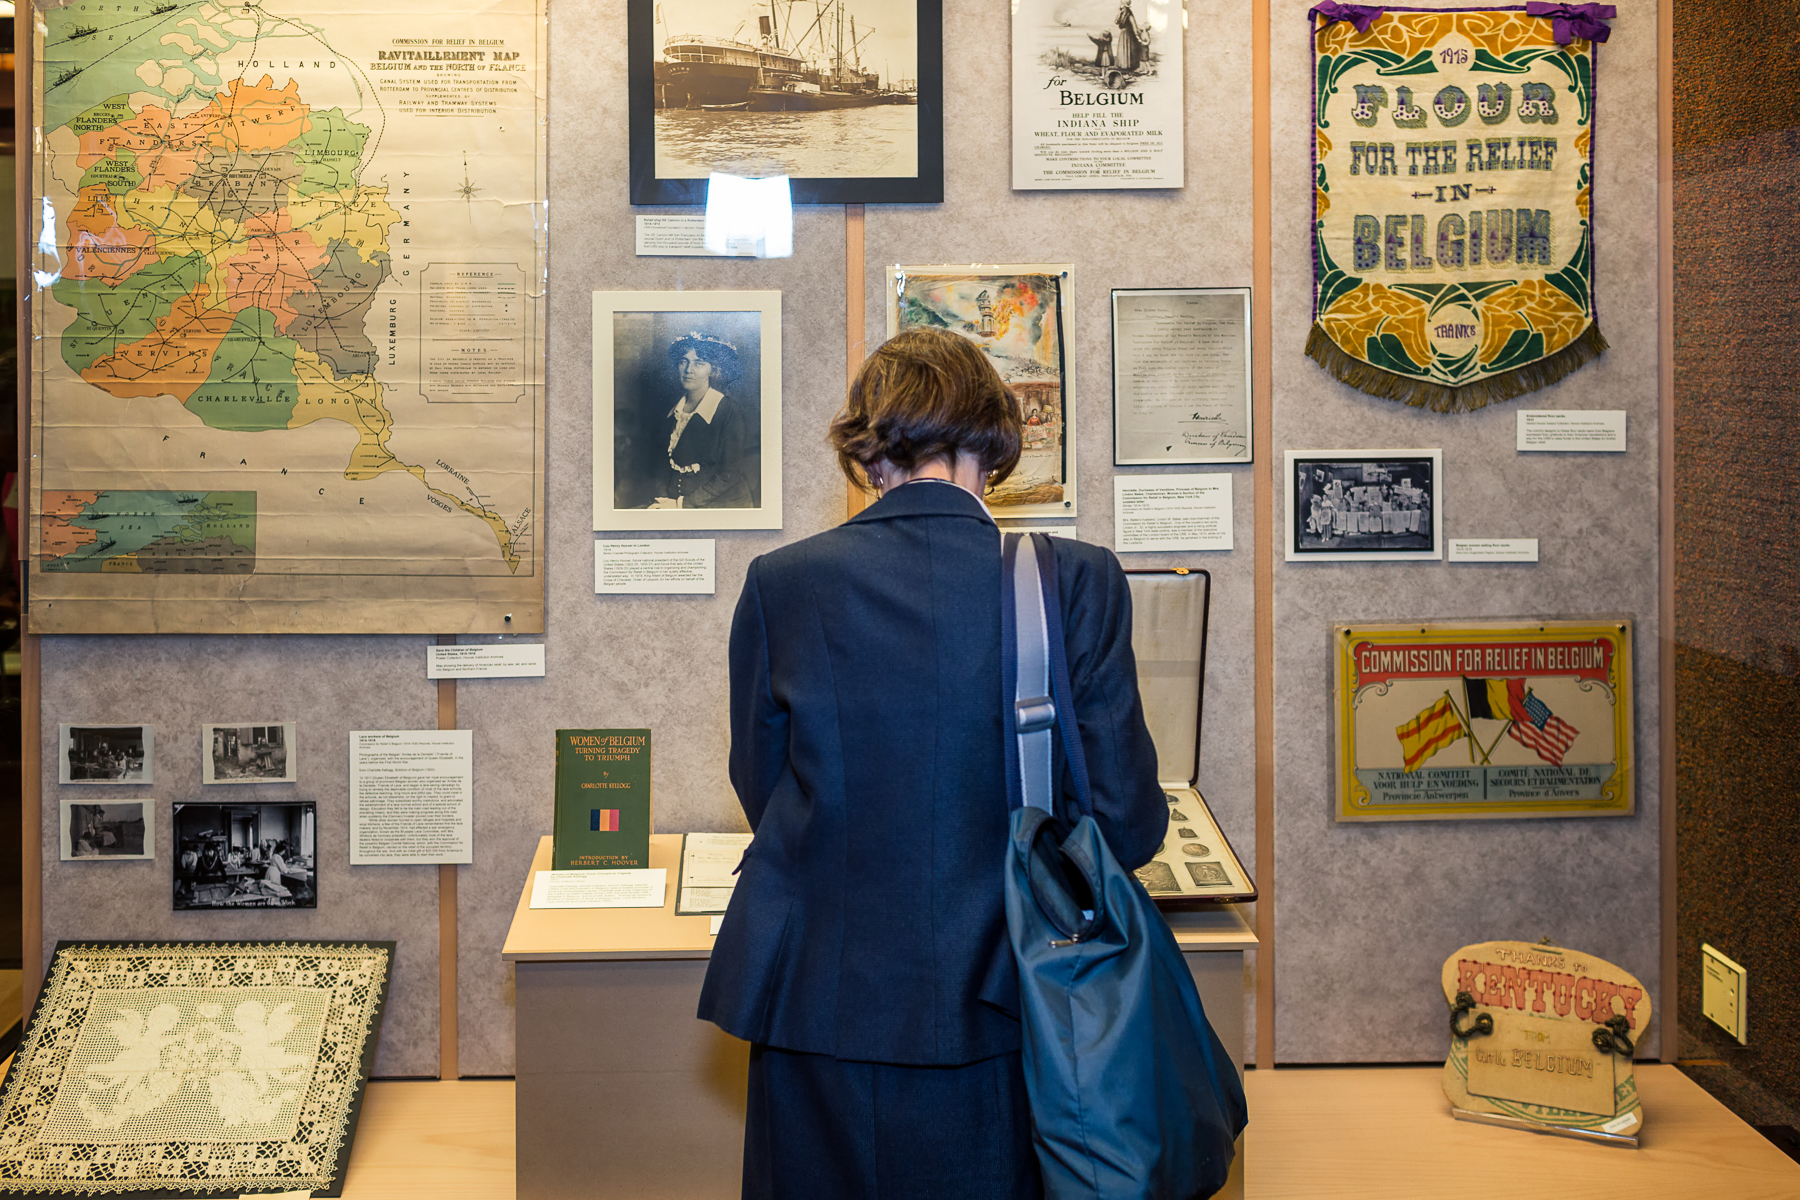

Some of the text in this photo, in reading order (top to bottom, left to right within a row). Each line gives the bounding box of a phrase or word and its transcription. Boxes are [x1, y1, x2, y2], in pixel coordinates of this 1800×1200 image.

[378, 50, 520, 61] RAVITAILLEMENT MAP
[1439, 48, 1468, 64] 1915
[238, 60, 336, 69] HOLLAND
[370, 63, 411, 71] BELGIUM
[445, 64, 475, 72] NORTH
[488, 64, 526, 72] FRANCE
[1043, 75, 1067, 90] for
[1060, 90, 1144, 106] BELGIUM
[1351, 81, 1559, 129] FLOUR
[1057, 119, 1140, 128] INDIANA SHIP
[1350, 137, 1557, 176] FOR THE RELIEF
[107, 180, 136, 188] (SOUTH)
[1434, 183, 1472, 203] IN
[402, 171, 410, 276] GERMANY
[1353, 208, 1557, 274] BELGIUM
[388, 298, 397, 366] LUXEMBURG
[1434, 323, 1476, 339] THANKS
[435, 458, 470, 485] LORRAINE
[426, 494, 452, 514] VOSGES
[511, 507, 532, 534] ALSACE
[1361, 646, 1604, 673] COMMISSION FOR RELIEF IN BELGIUM
[570, 736, 646, 746] WOMEN of BELGIUM
[1534, 768, 1576, 777] NATIONAL
[1580, 767, 1592, 776] DE
[1374, 780, 1397, 790] VOOR
[1427, 780, 1439, 788] EN
[1440, 780, 1479, 788] VOEDING
[1382, 791, 1469, 801] Provincie Antwerpen
[1508, 789, 1541, 798] Province
[1496, 949, 1565, 969] THANKS
[1457, 959, 1643, 1030] KENTUCKY
